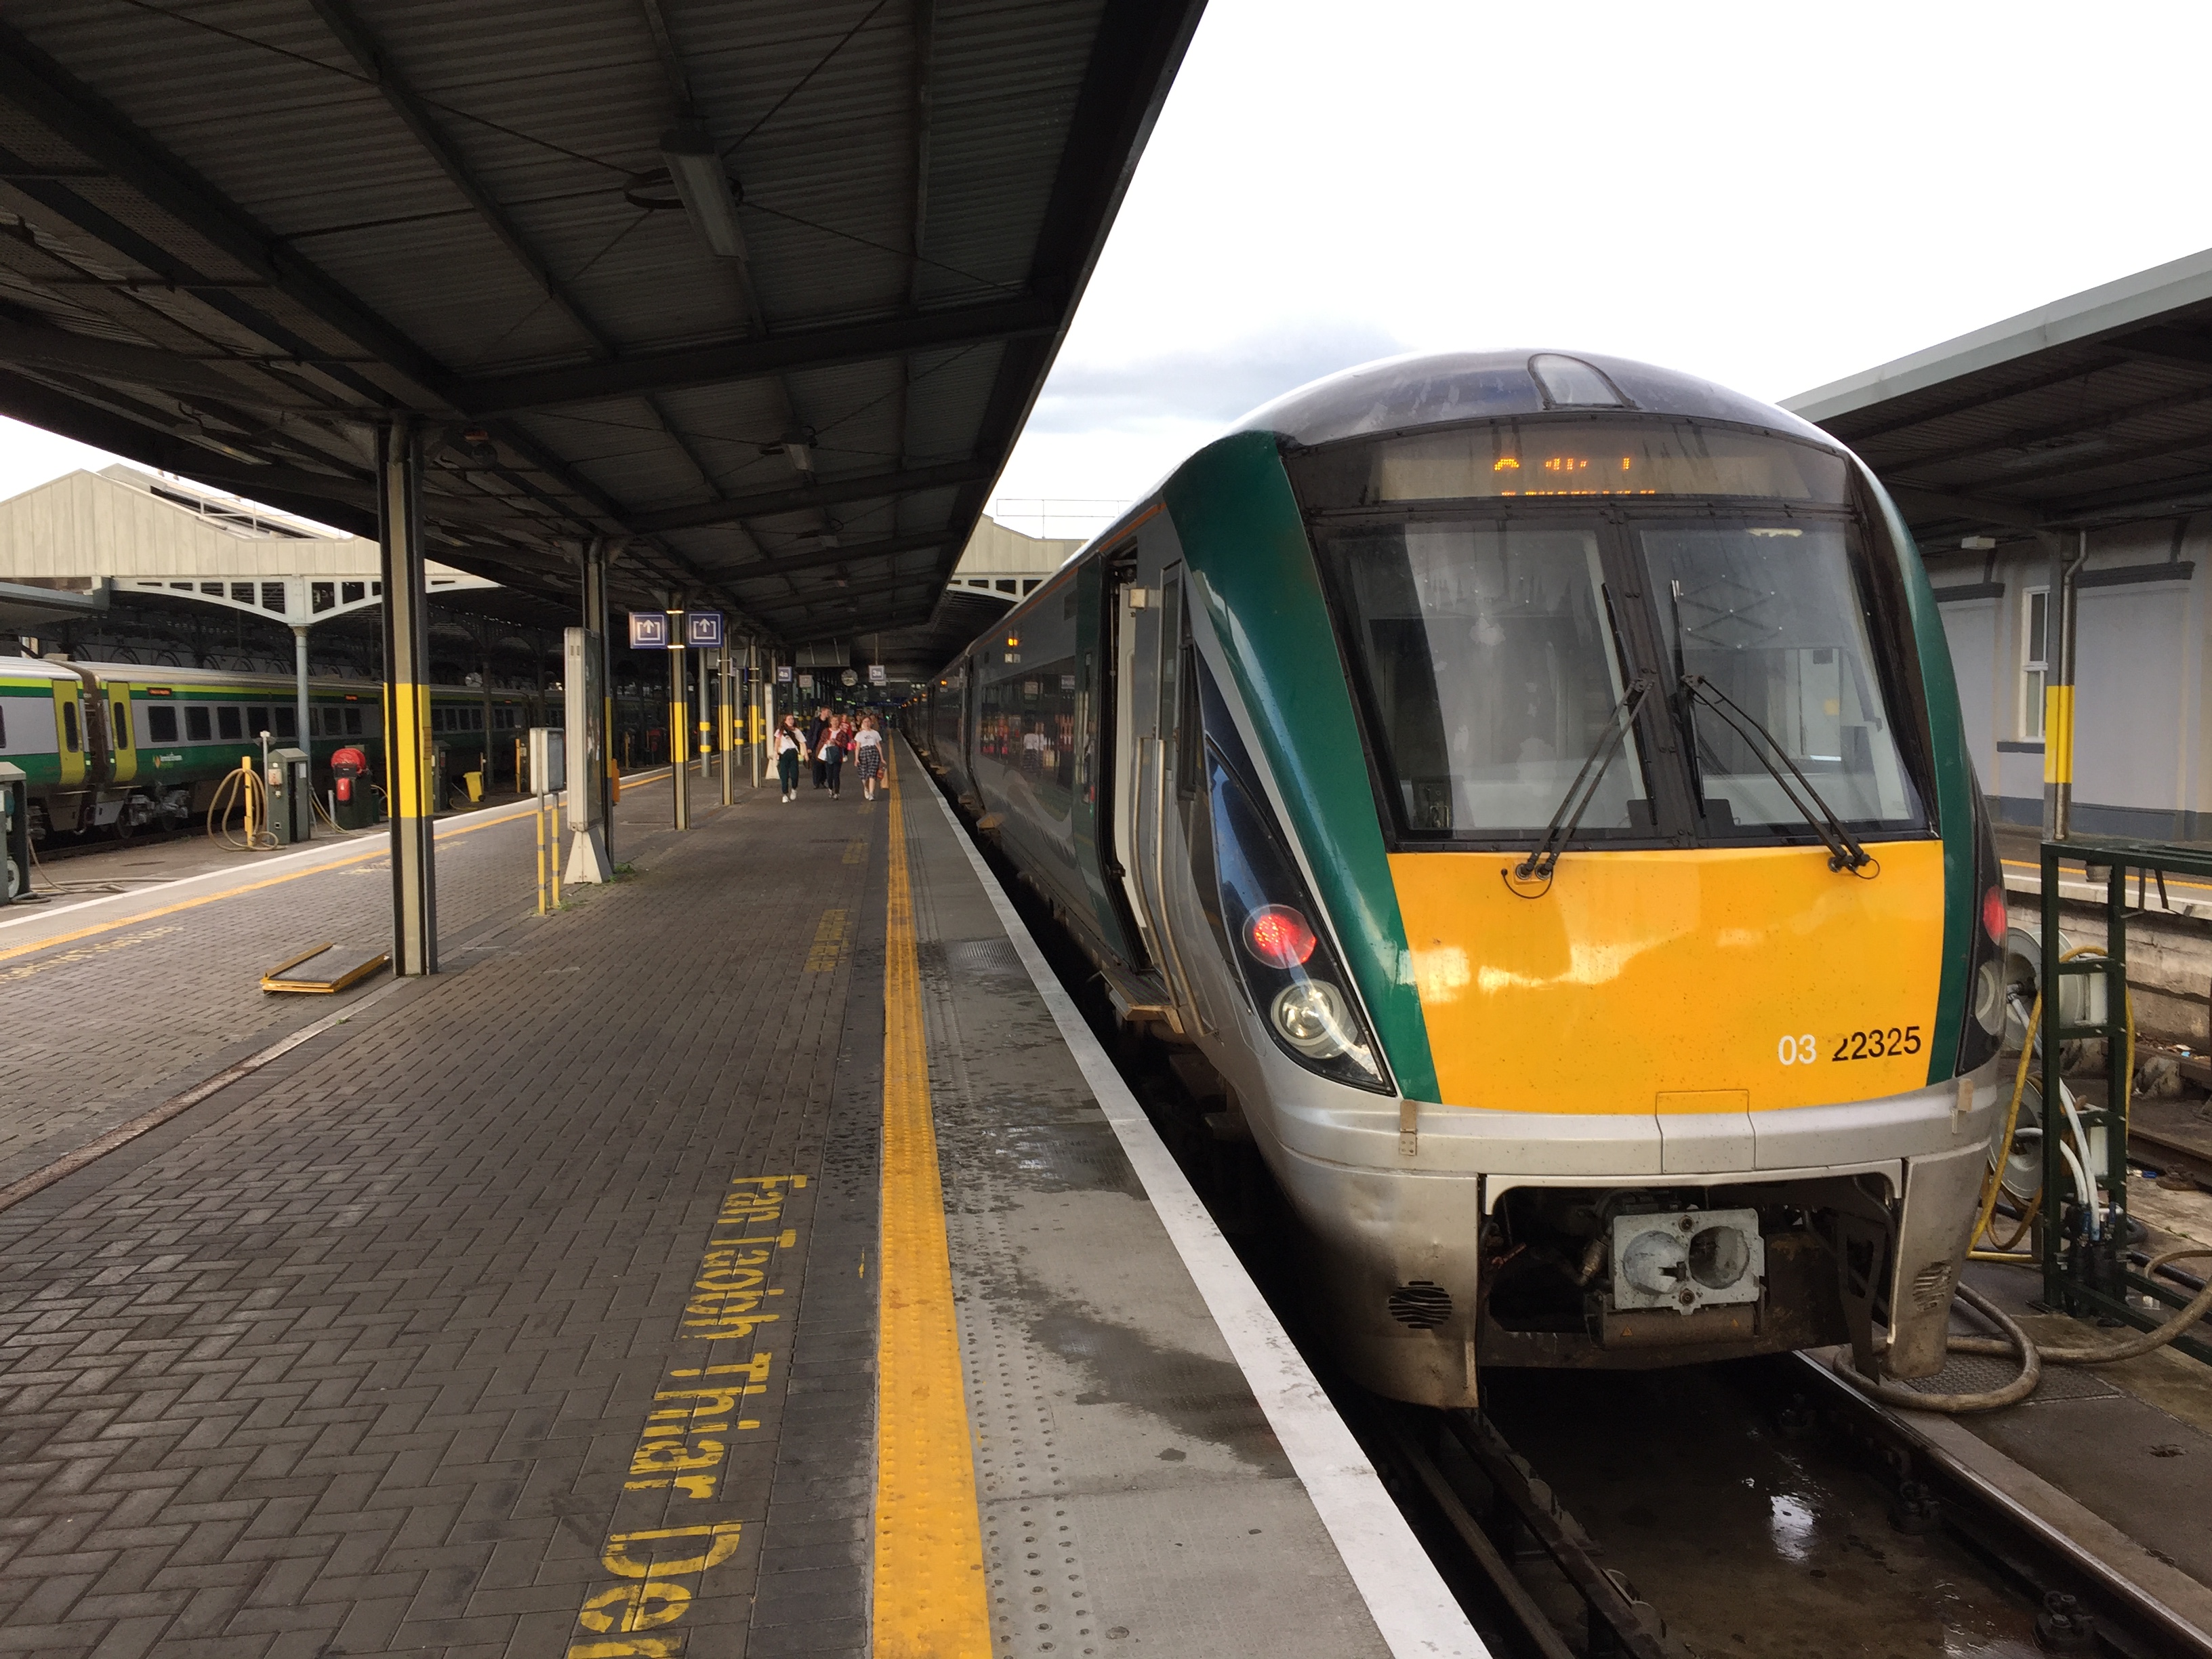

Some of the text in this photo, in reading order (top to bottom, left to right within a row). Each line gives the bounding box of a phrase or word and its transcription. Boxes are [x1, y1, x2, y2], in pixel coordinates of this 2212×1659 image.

[1778, 1025, 1921, 1065] 03 22325
[717, 1174, 808, 1224] Fan
[680, 1229, 797, 1340] Taobh
[623, 1352, 772, 1498] Thiar
